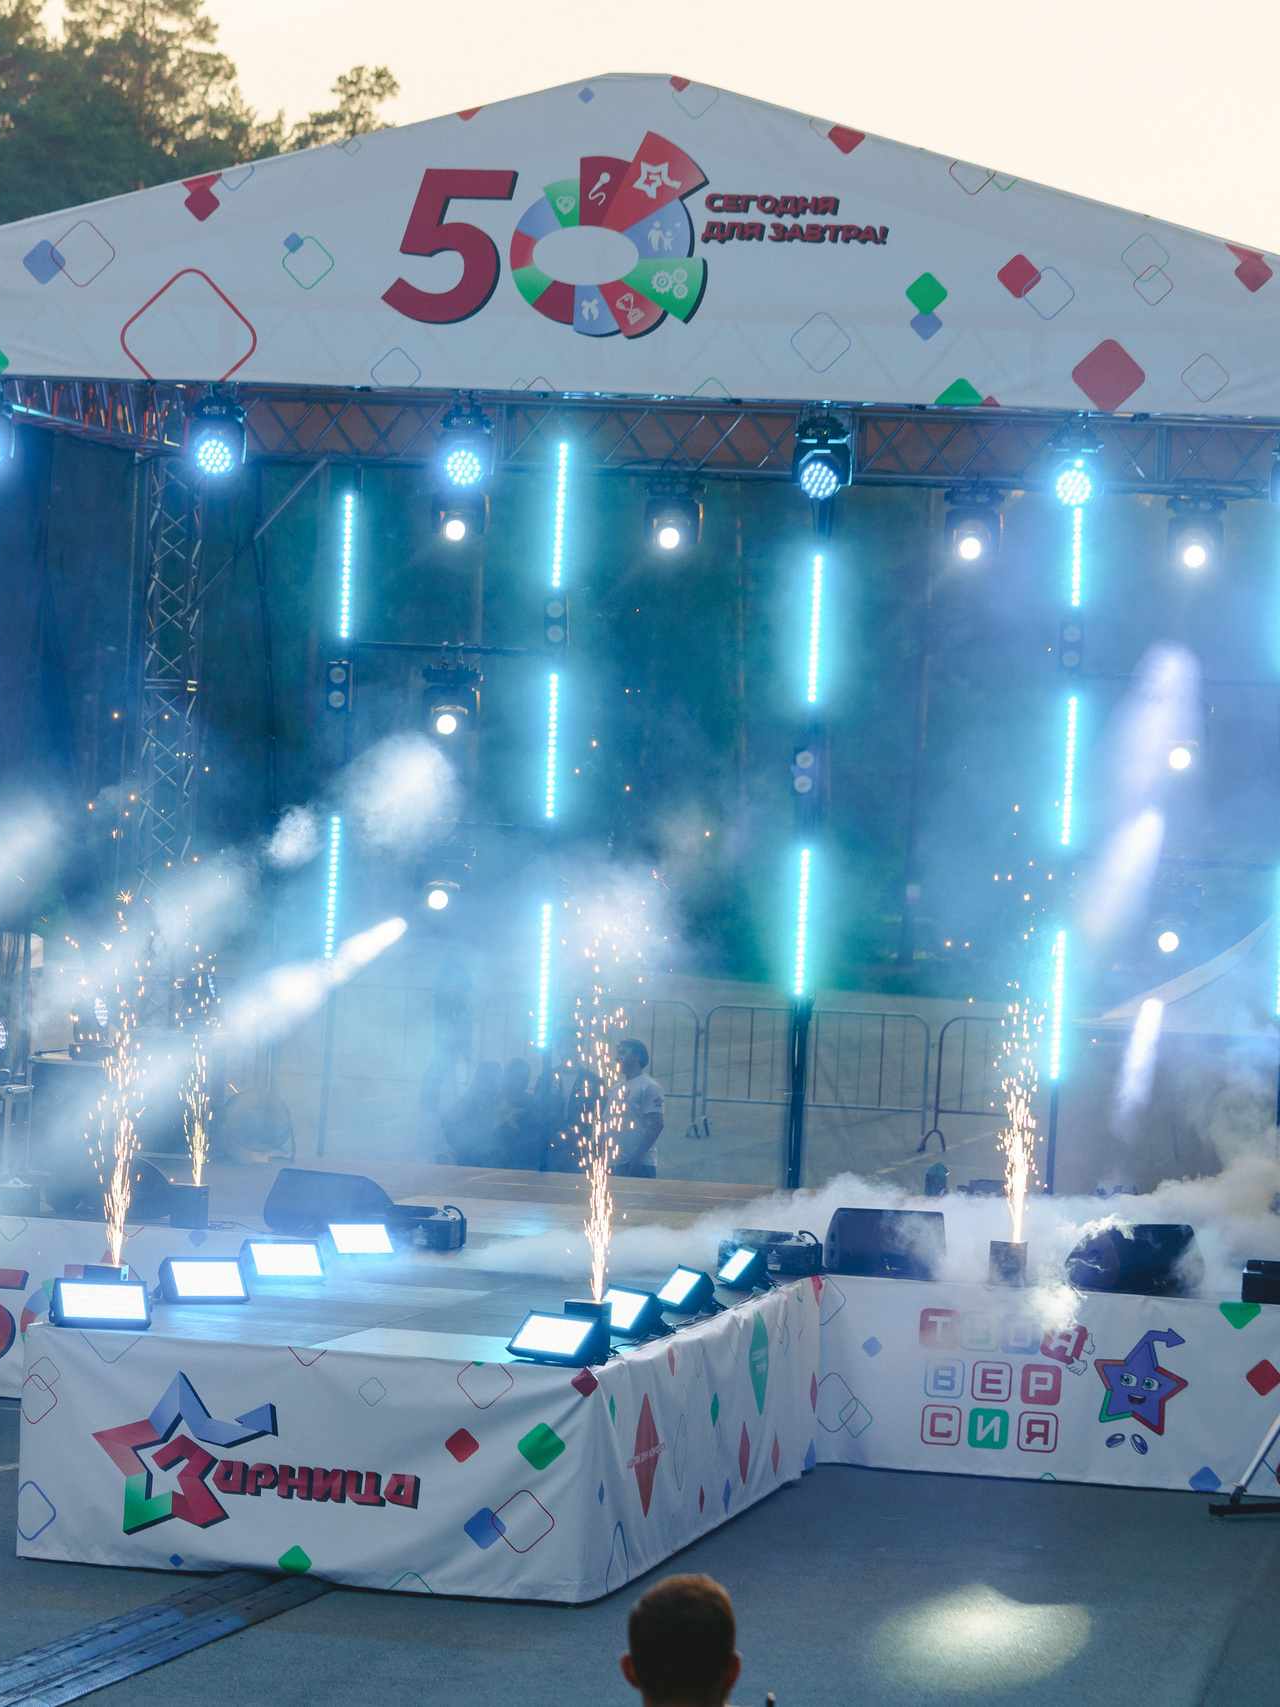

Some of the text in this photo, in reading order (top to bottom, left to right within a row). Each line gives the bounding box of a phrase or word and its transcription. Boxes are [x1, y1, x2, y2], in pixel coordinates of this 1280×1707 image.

[705, 193, 840, 218] СЕГОДНЯ
[702, 221, 889, 245] ДЛЯ ЗАВТРА!
[931, 1365, 1056, 1398] ВЕР
[928, 1411, 1051, 1446] СИЯ
